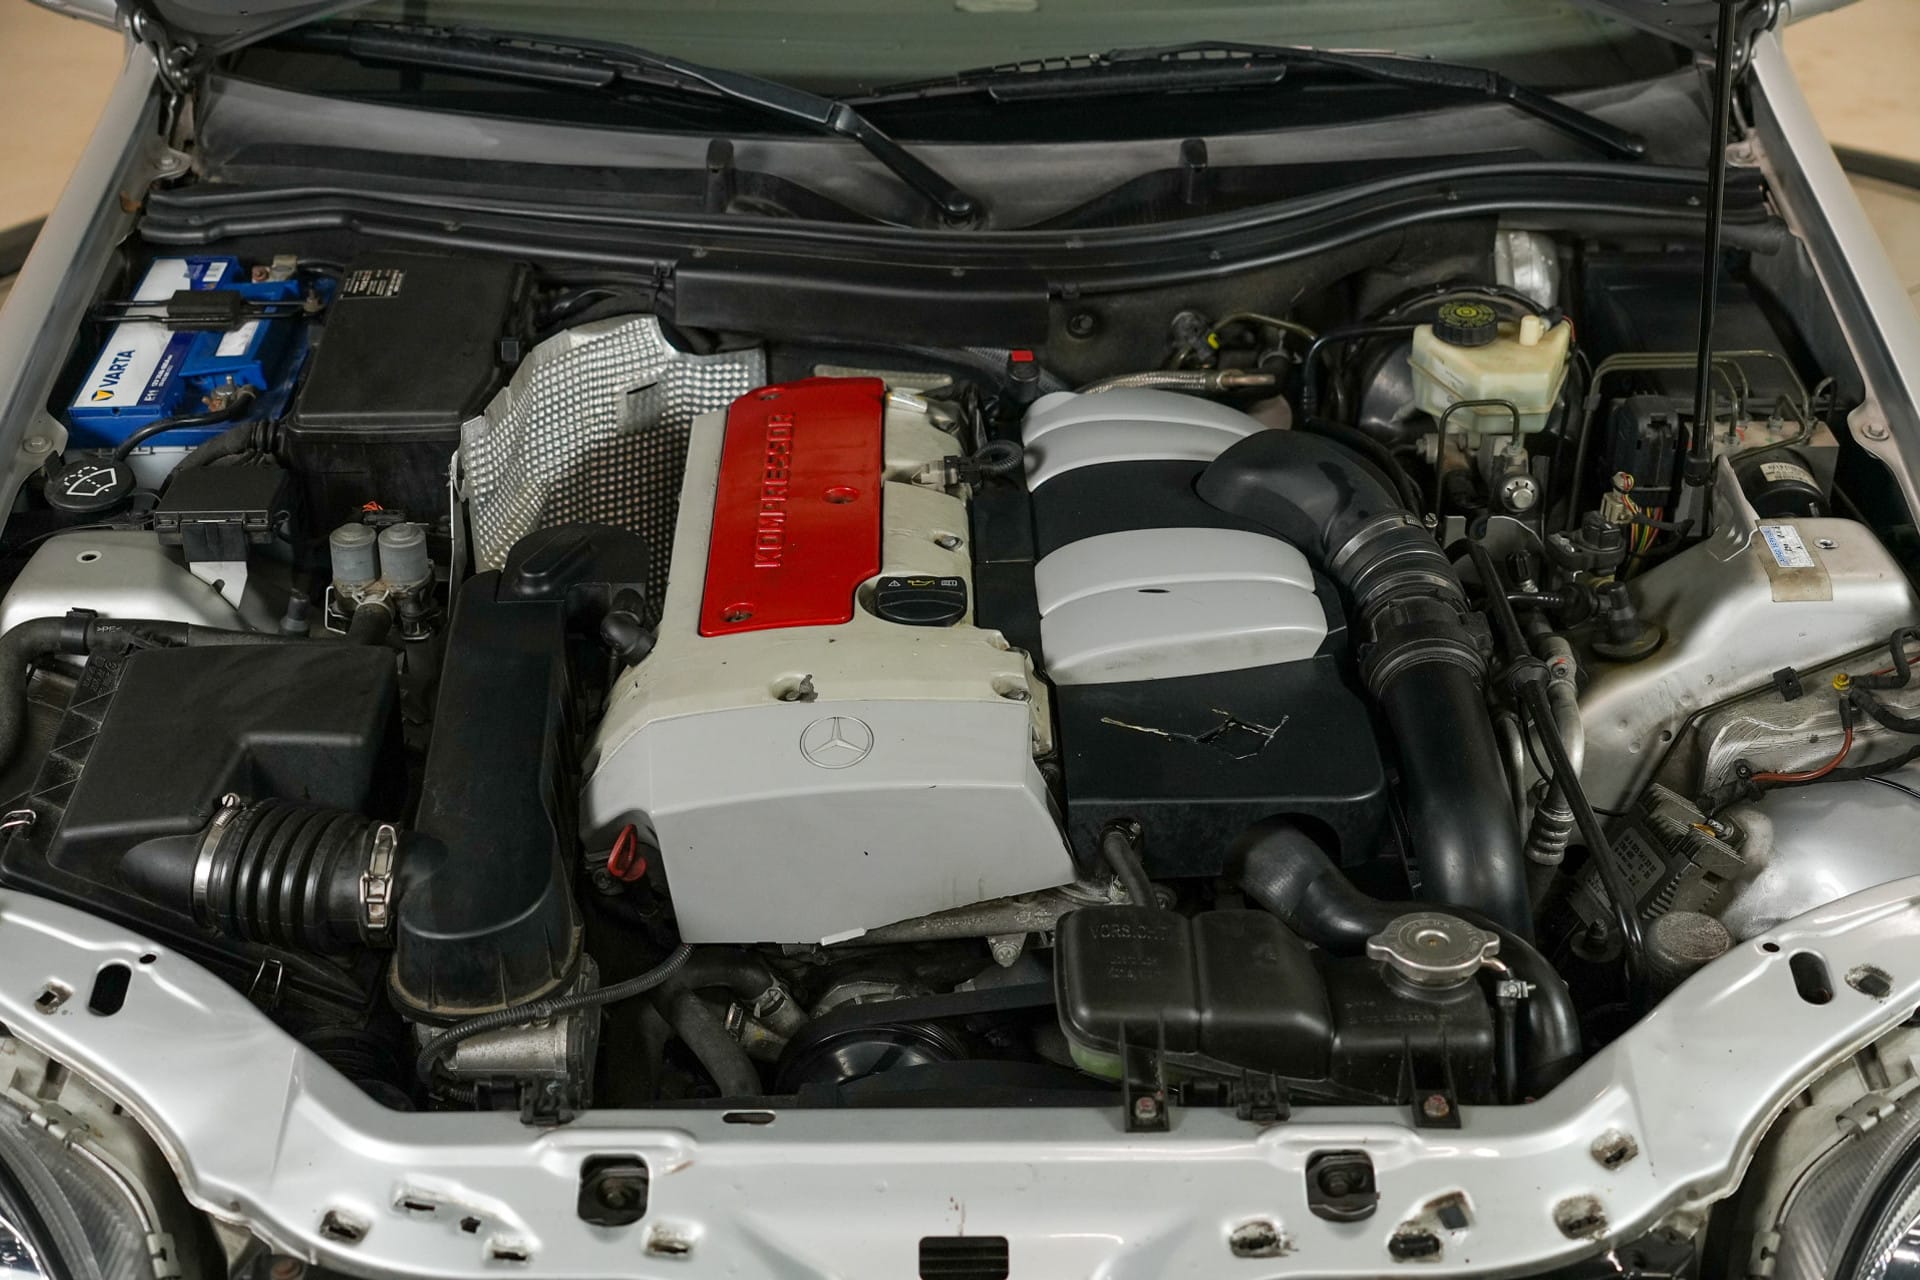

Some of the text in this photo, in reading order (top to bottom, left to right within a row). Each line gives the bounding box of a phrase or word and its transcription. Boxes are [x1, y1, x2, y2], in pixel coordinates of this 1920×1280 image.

[99, 349, 137, 387] VARTA
[144, 386, 161, 402] E11
[754, 413, 793, 568] KOMPRESSOR
[1089, 923, 1167, 940] VORSICHT
